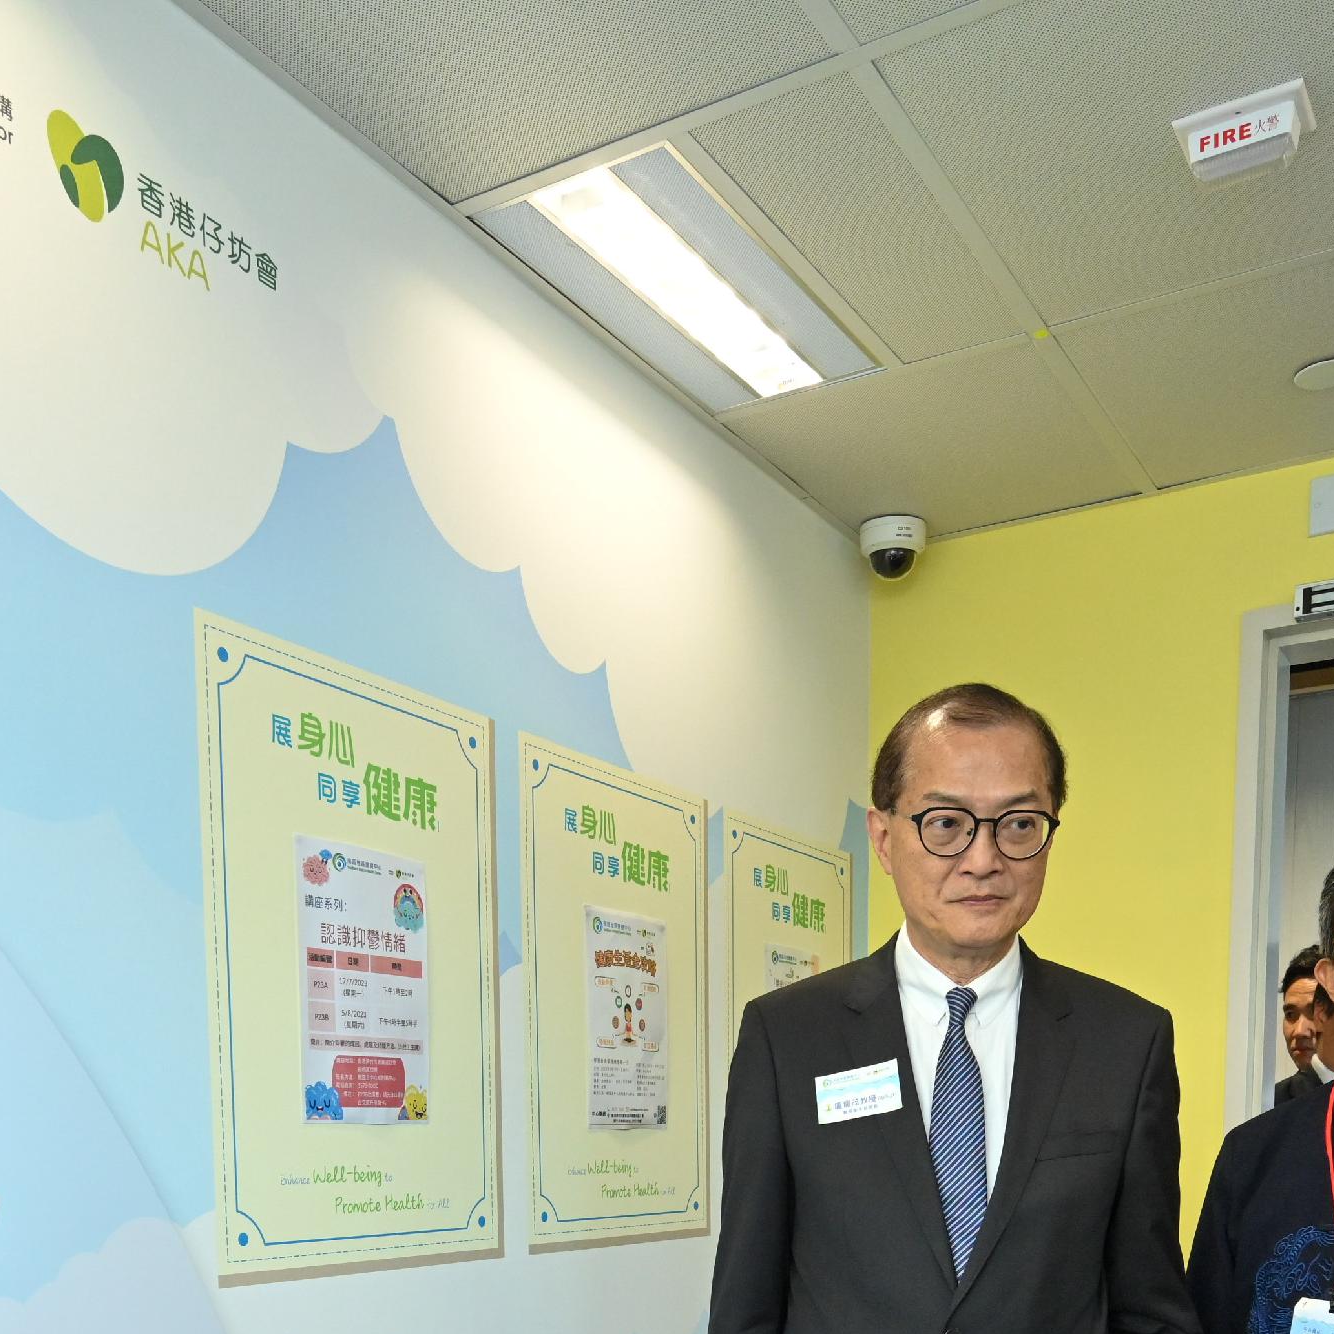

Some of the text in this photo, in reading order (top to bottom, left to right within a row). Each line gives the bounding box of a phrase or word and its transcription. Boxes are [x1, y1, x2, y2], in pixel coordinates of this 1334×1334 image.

[1199, 112, 1280, 153] FIRE 火警
[137, 173, 279, 291] 香港仔坊會
[140, 221, 210, 292] AKA
[271, 712, 355, 768] 展身心
[317, 762, 439, 832] 同享健康
[564, 805, 616, 846] 展身心
[592, 842, 670, 892] 同享健康
[753, 864, 789, 896] 展身心
[772, 892, 826, 933] 同享健康
[320, 922, 406, 953] 認識抑鬱情緒
[313, 1165, 382, 1187] Well-being
[587, 1159, 632, 1178] Well-being
[335, 1196, 381, 1214] Promote
[385, 1193, 424, 1213] Health
